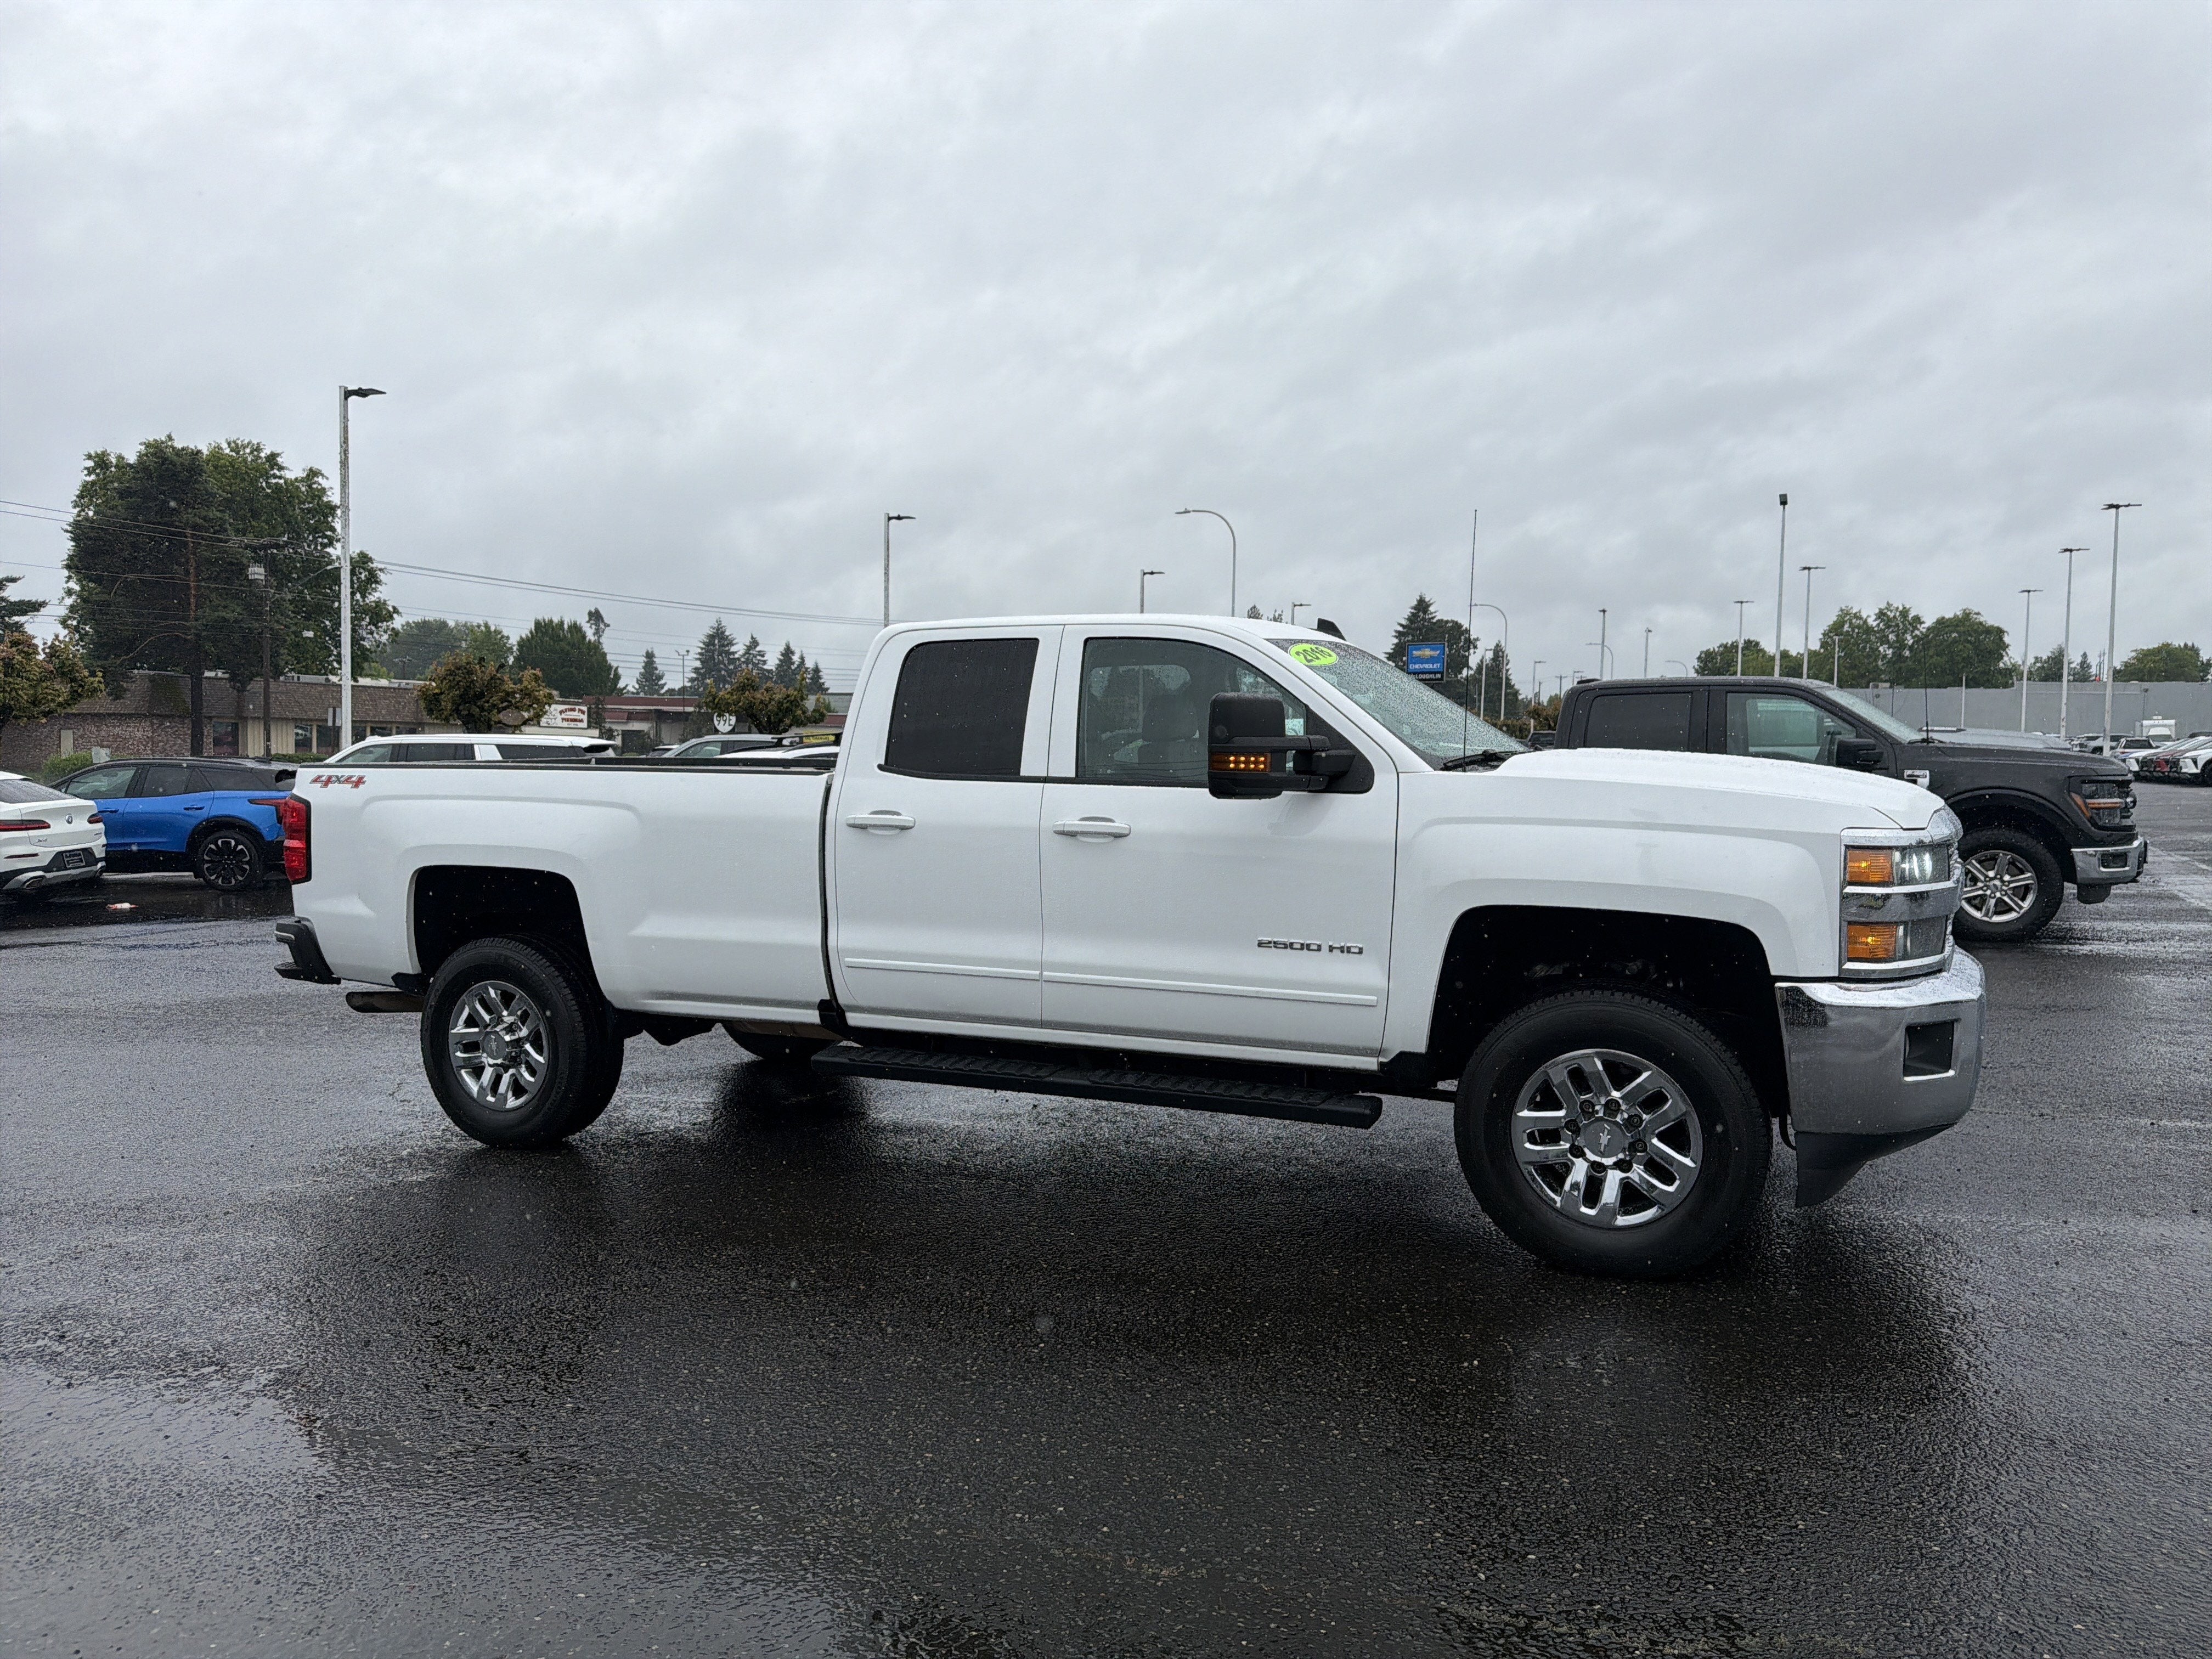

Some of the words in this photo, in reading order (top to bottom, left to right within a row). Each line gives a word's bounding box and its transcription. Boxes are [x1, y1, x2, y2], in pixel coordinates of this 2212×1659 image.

[1295, 646, 1333, 663] 2016
[715, 713, 733, 726] 99E
[1257, 937, 1322, 952] 2500
[1328, 940, 1363, 955] HD
